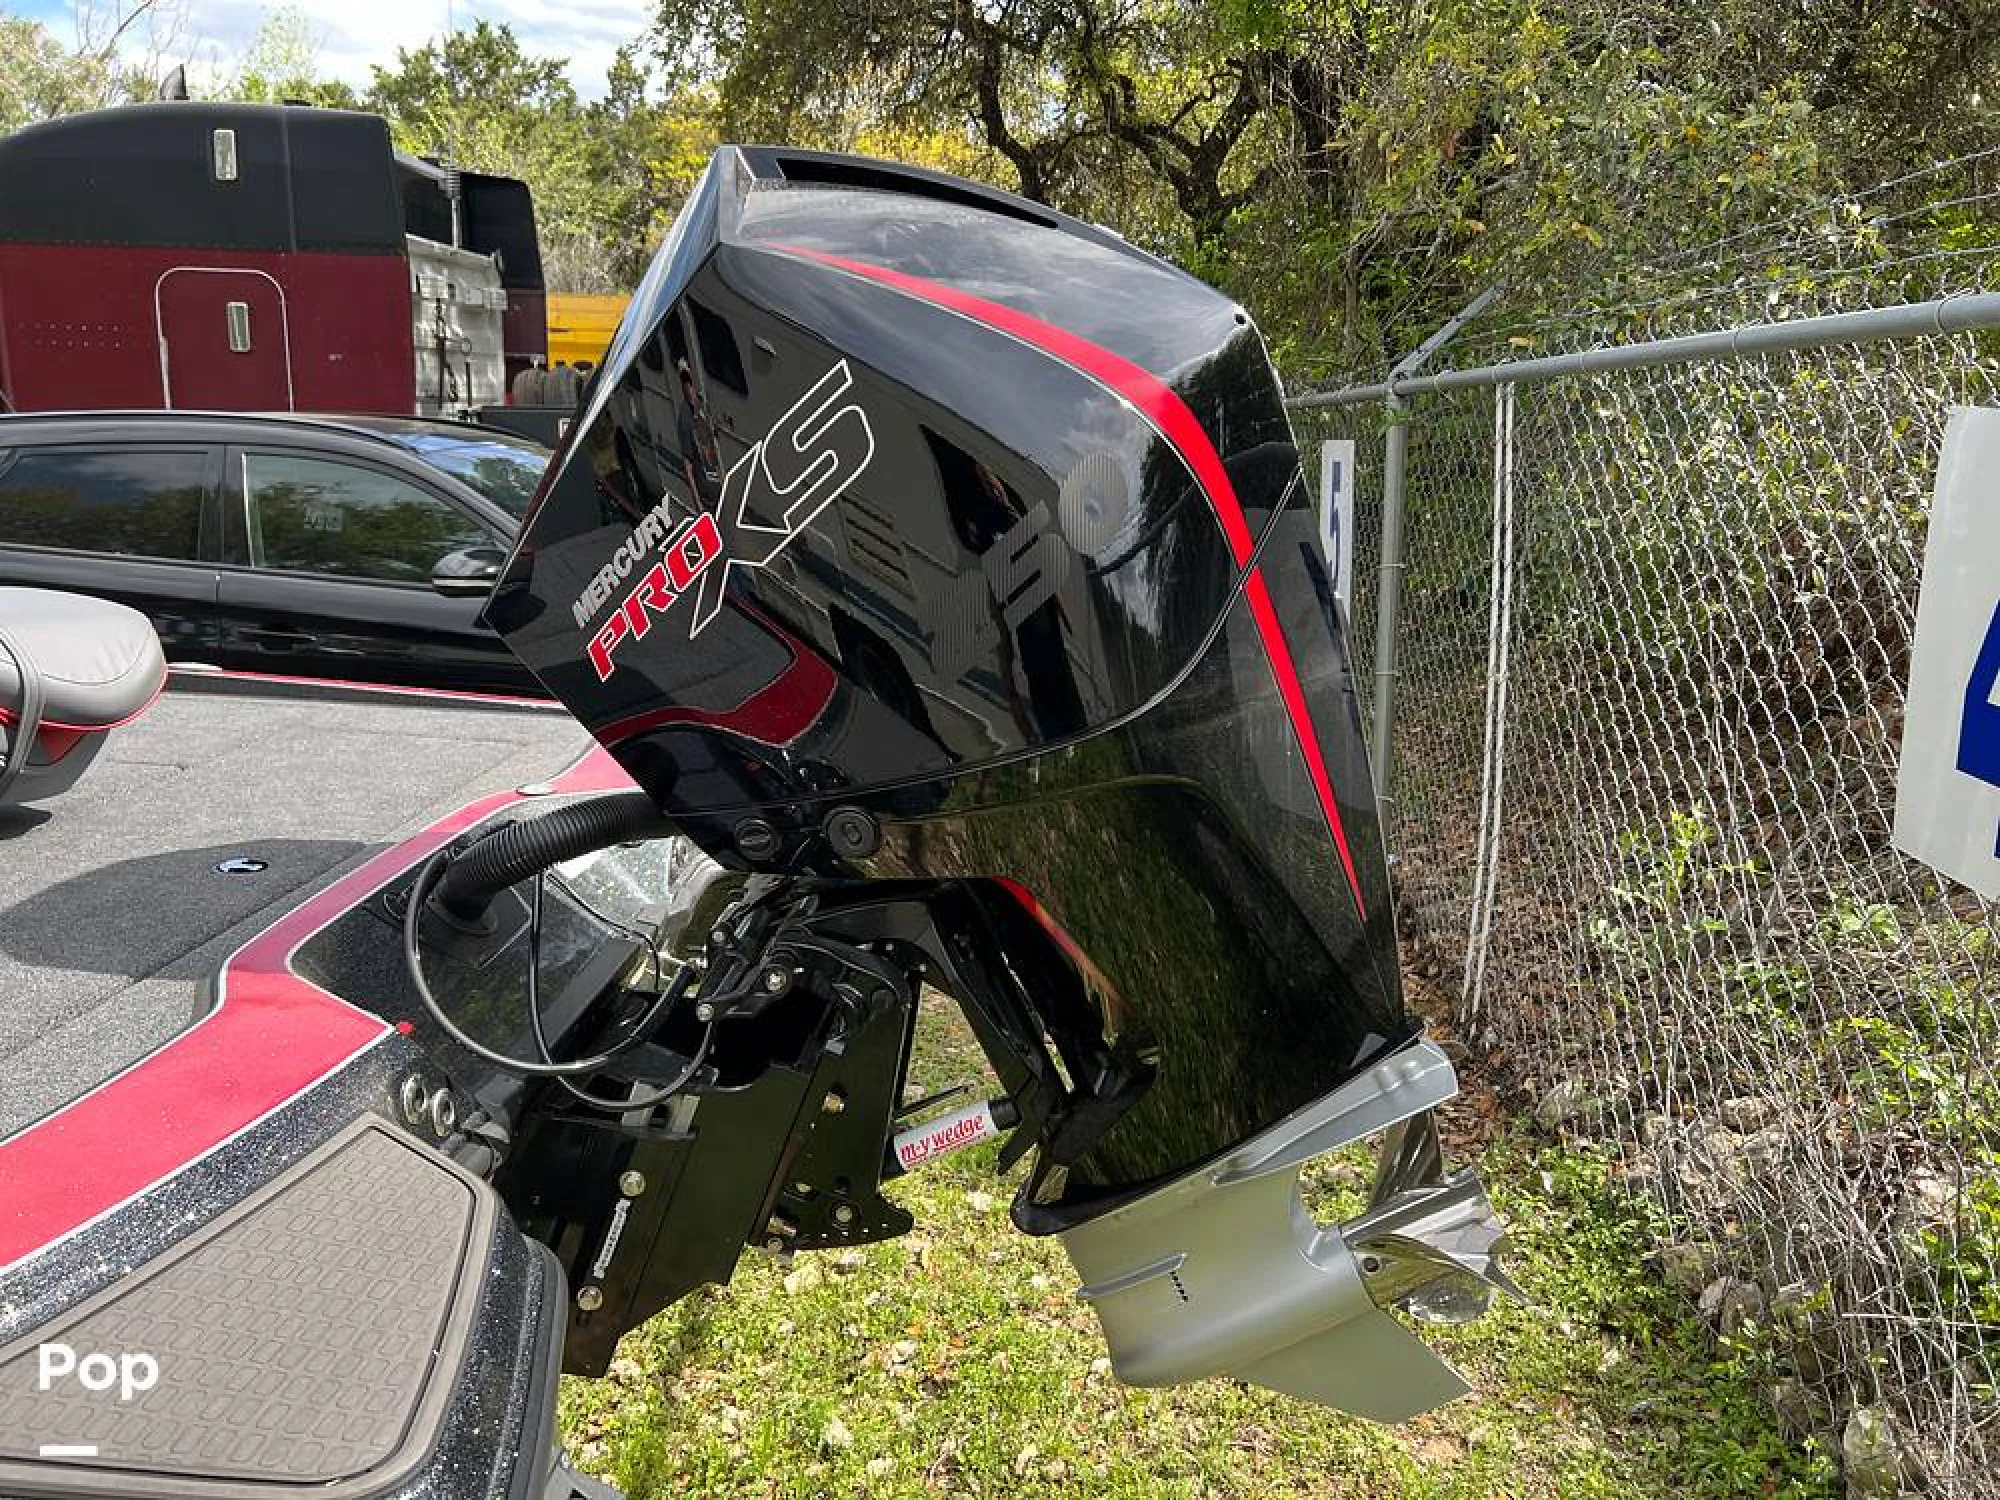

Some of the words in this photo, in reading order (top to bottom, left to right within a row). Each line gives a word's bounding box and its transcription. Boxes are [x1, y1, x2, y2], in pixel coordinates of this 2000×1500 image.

[571, 493, 674, 639] MERCURY
[587, 511, 722, 682] PRO
[660, 357, 874, 640] XS
[931, 1115, 985, 1149] wedge
